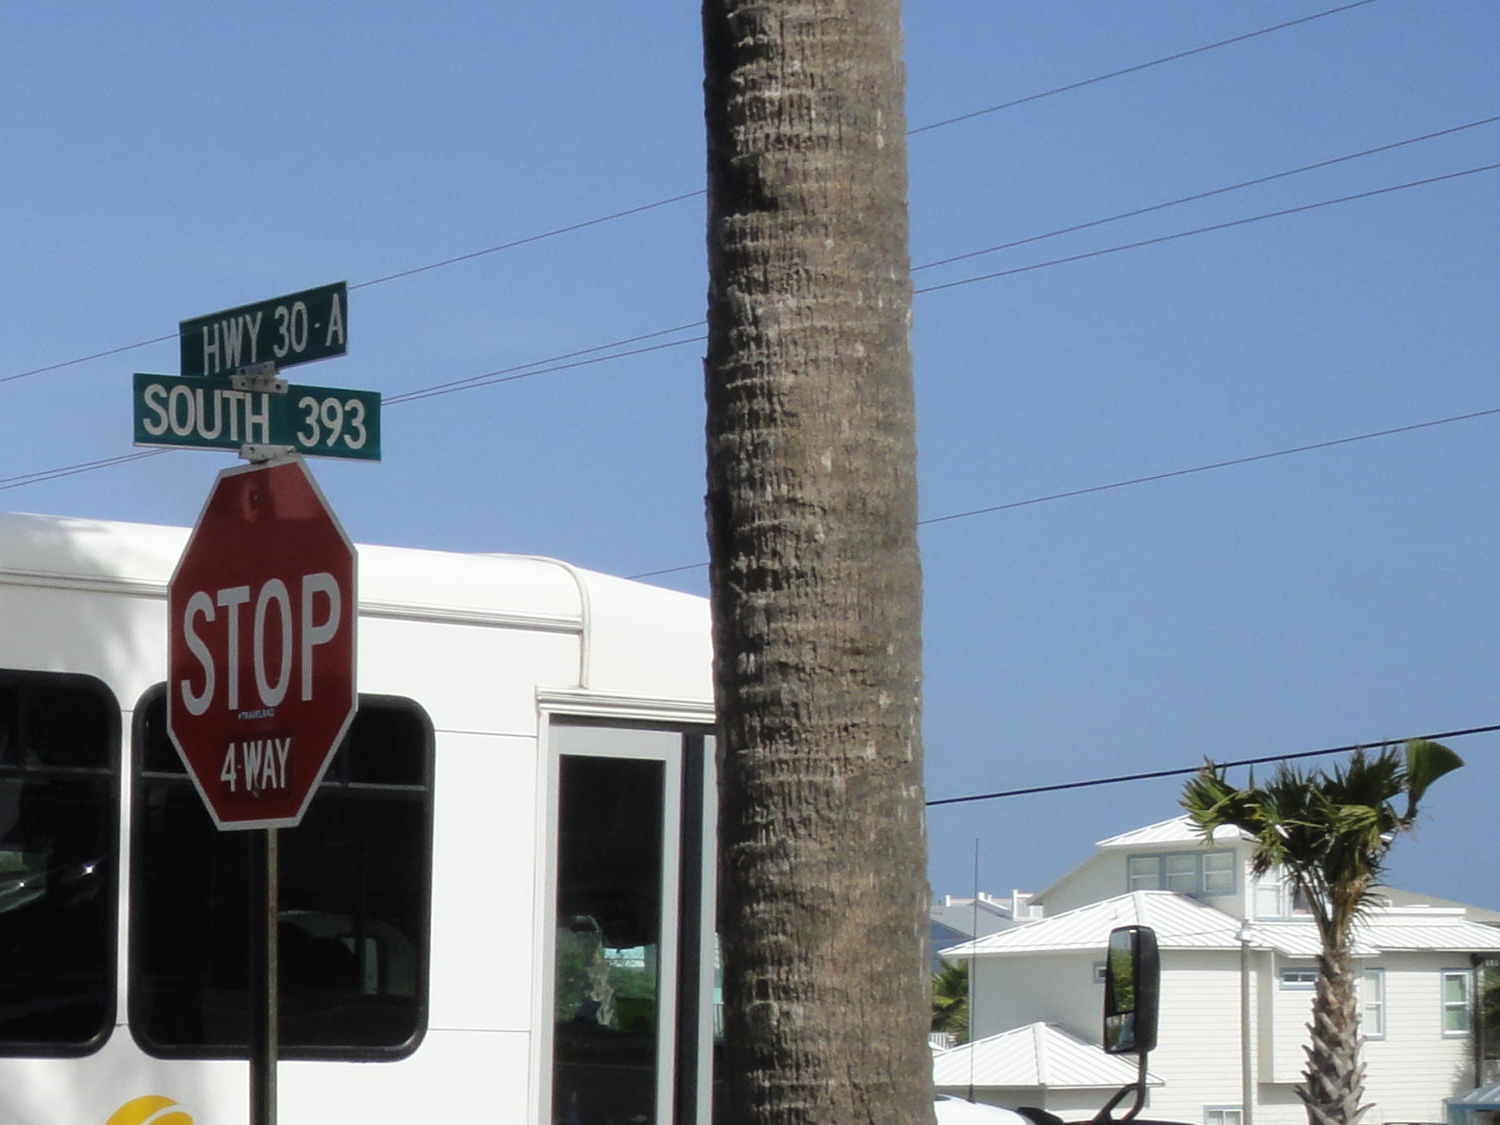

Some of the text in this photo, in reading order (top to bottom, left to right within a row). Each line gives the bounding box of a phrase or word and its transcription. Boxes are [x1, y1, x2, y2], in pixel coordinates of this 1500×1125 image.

[203, 312, 262, 376] HWY
[143, 383, 366, 449] SOUTH 393
[181, 572, 341, 716] STOP
[221, 737, 291, 792] 4-WAY
